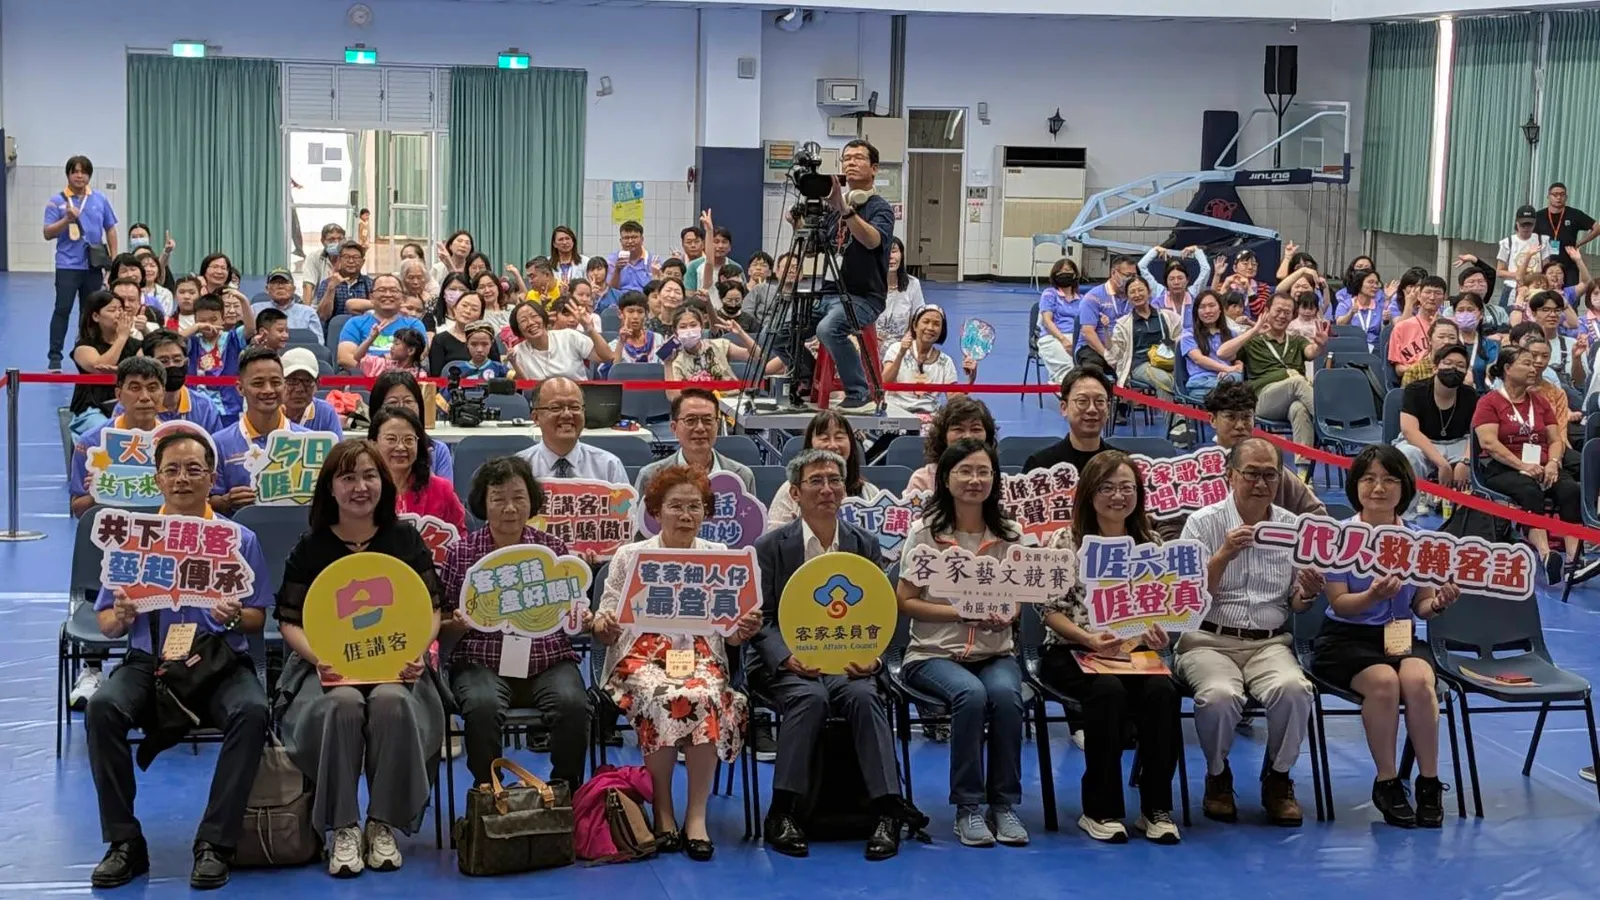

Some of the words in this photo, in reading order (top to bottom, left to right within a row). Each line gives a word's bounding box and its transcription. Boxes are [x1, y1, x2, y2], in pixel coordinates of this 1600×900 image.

[1249, 172, 1290, 180] JINLING
[272, 437, 332, 468] 今日
[96, 473, 160, 497] 共下來
[98, 513, 234, 557] 共下講客
[107, 551, 245, 592] 藝起傳承
[911, 550, 1069, 590] 客家藝文競賽
[1025, 553, 1069, 563] 全國中小學
[472, 559, 545, 594] 客家話
[641, 562, 747, 586] 客家細人仔
[646, 586, 738, 617] 最登真
[795, 624, 881, 641] 客家委員會
[851, 642, 877, 650] Council
